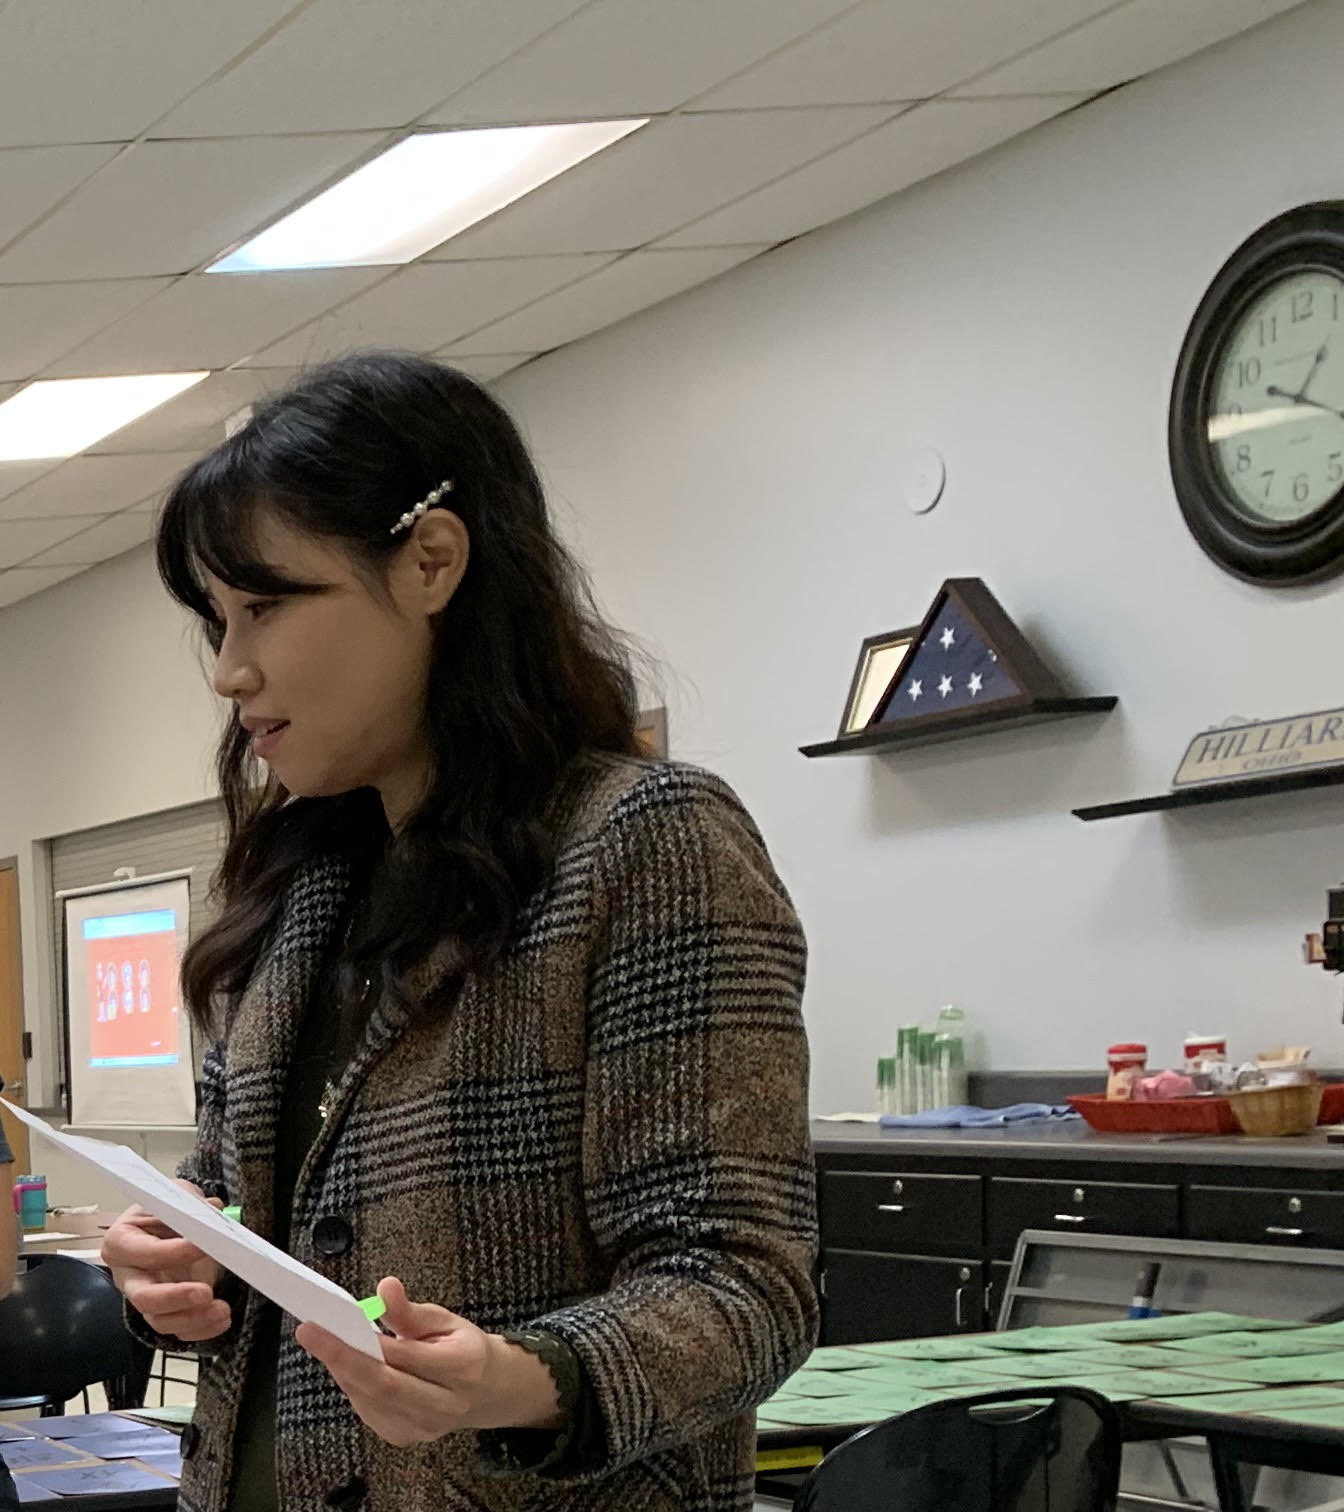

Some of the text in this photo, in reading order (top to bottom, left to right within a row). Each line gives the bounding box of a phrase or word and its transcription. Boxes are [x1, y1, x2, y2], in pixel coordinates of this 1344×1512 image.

[1291, 291, 1313, 323] 12
[1259, 316, 1277, 347] 11
[1237, 356, 1261, 389] 10
[1236, 444, 1251, 473] 8
[1327, 450, 1343, 483] 5
[1261, 469, 1275, 498] 7
[1293, 472, 1309, 503] 6
